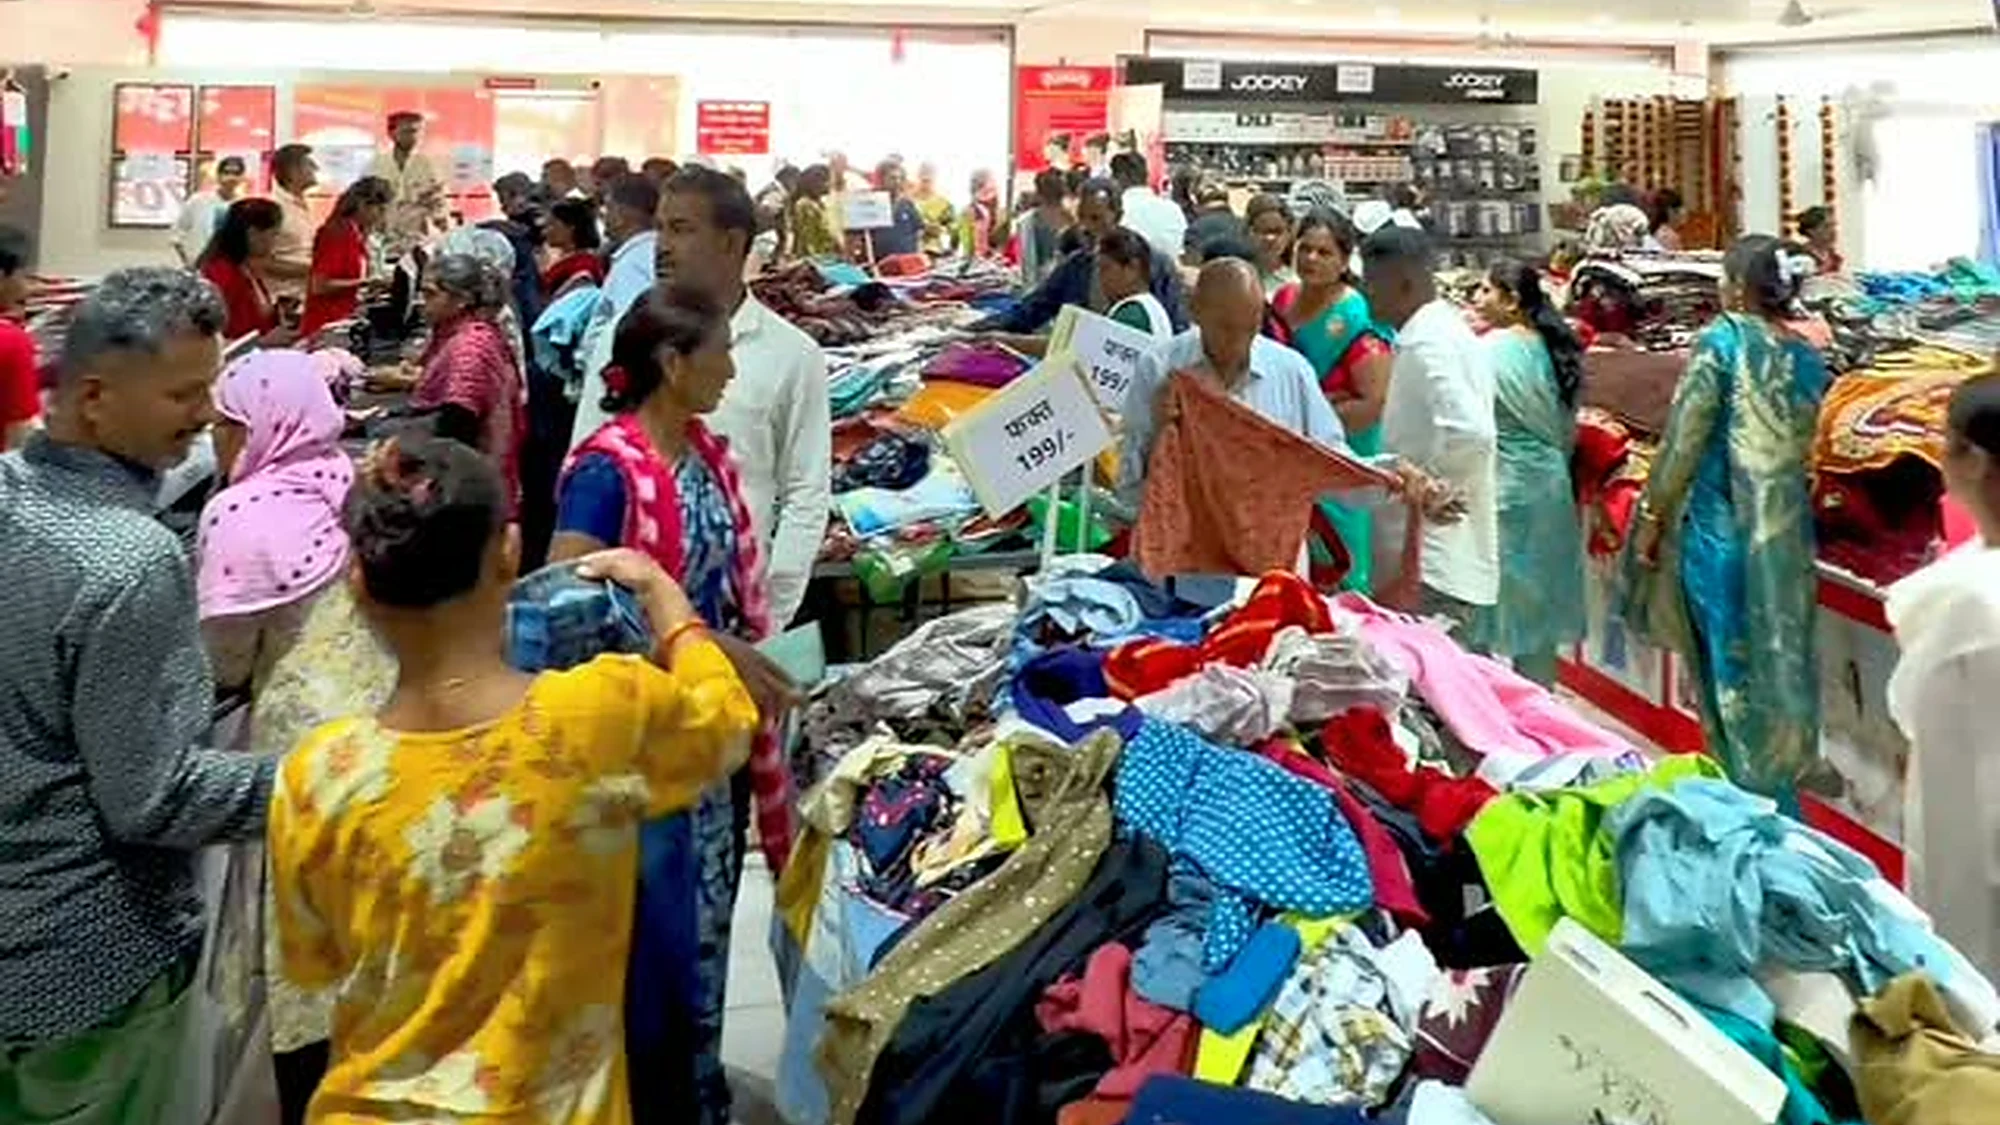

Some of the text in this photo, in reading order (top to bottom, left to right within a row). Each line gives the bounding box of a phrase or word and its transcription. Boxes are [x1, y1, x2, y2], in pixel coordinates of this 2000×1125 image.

[1230, 74, 1308, 91] JOCKEY
[1004, 400, 1054, 437] फक्त
[1016, 429, 1075, 471] 199/-
